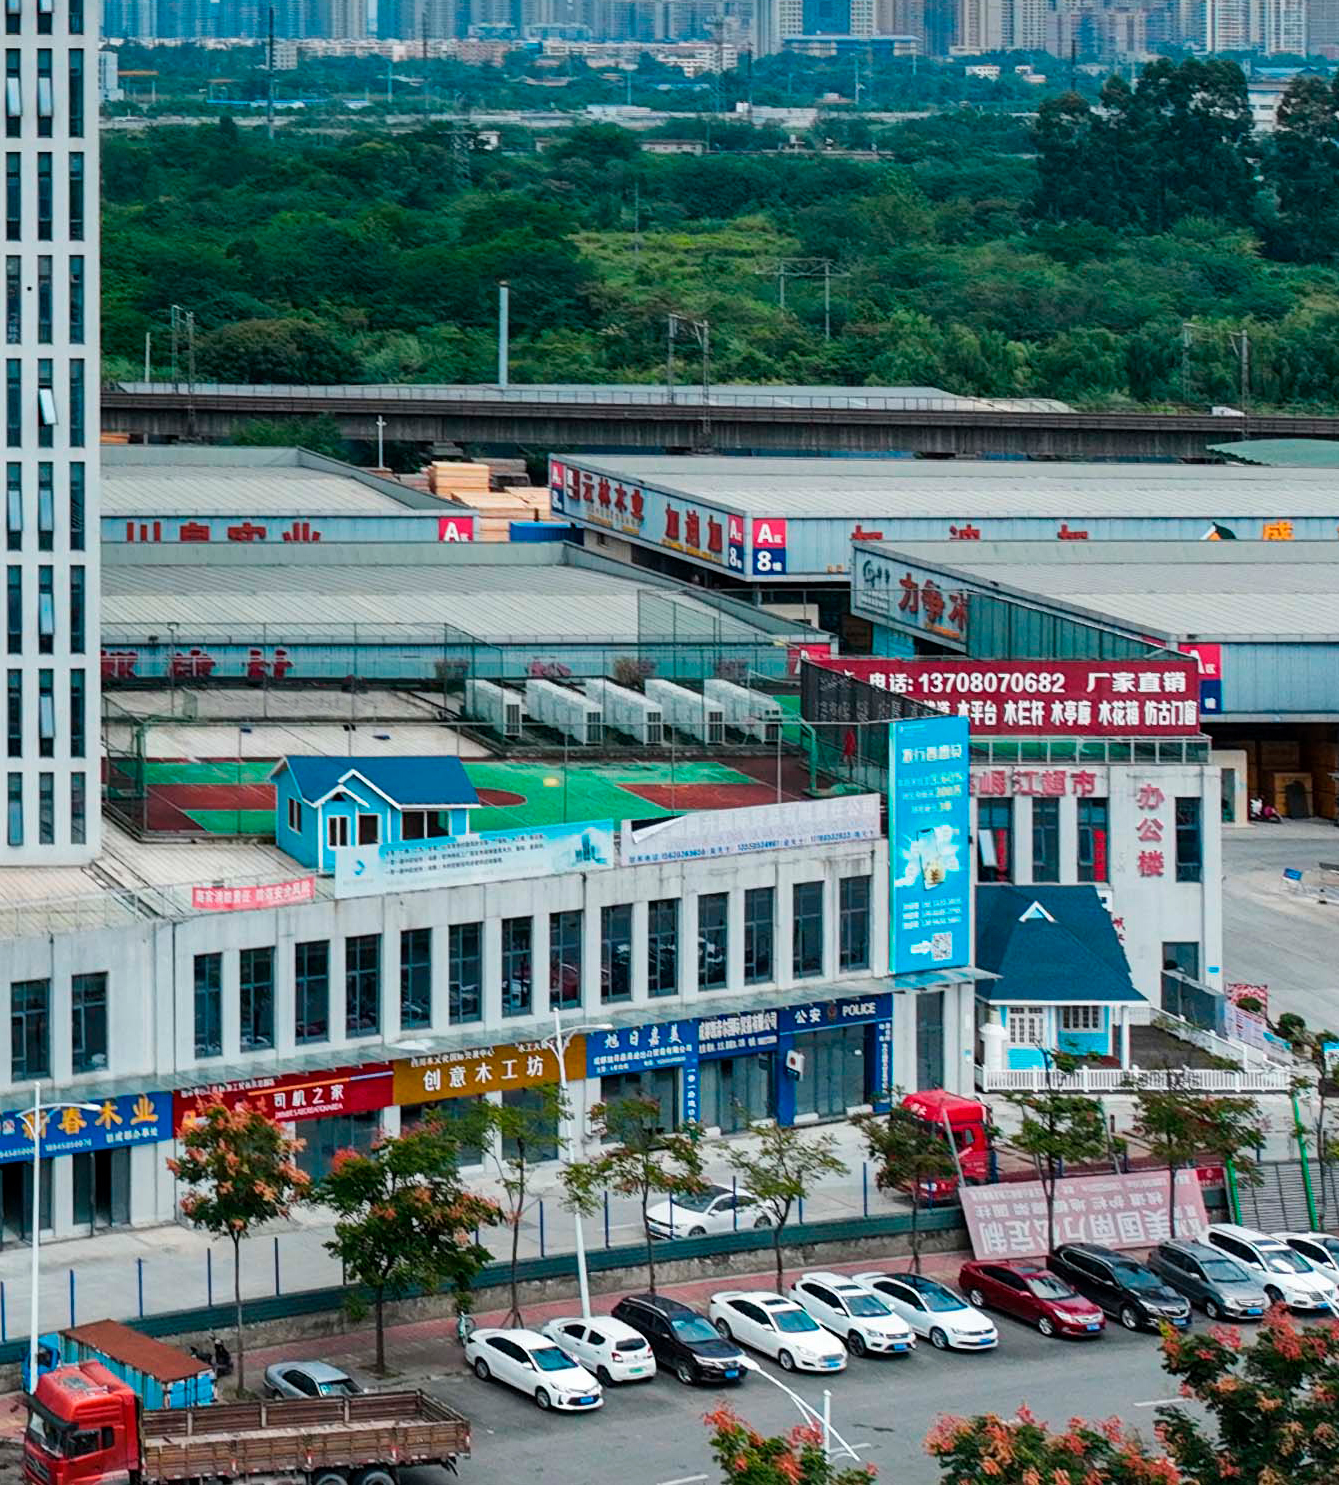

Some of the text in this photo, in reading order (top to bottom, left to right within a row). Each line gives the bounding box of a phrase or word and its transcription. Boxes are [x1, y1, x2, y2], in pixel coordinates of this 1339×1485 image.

[1087, 671, 1186, 693] 厂家直销
[1004, 699, 1045, 727] 木栏杆
[1099, 699, 1140, 727] 木花箱
[1145, 698, 1197, 726] 仿古门窗
[1136, 783, 1166, 878] 办公楼
[794, 1002, 877, 1024] 公安 POLICE
[423, 1056, 544, 1092] 创意木工坊
[274, 1084, 345, 1110] 司机之家
